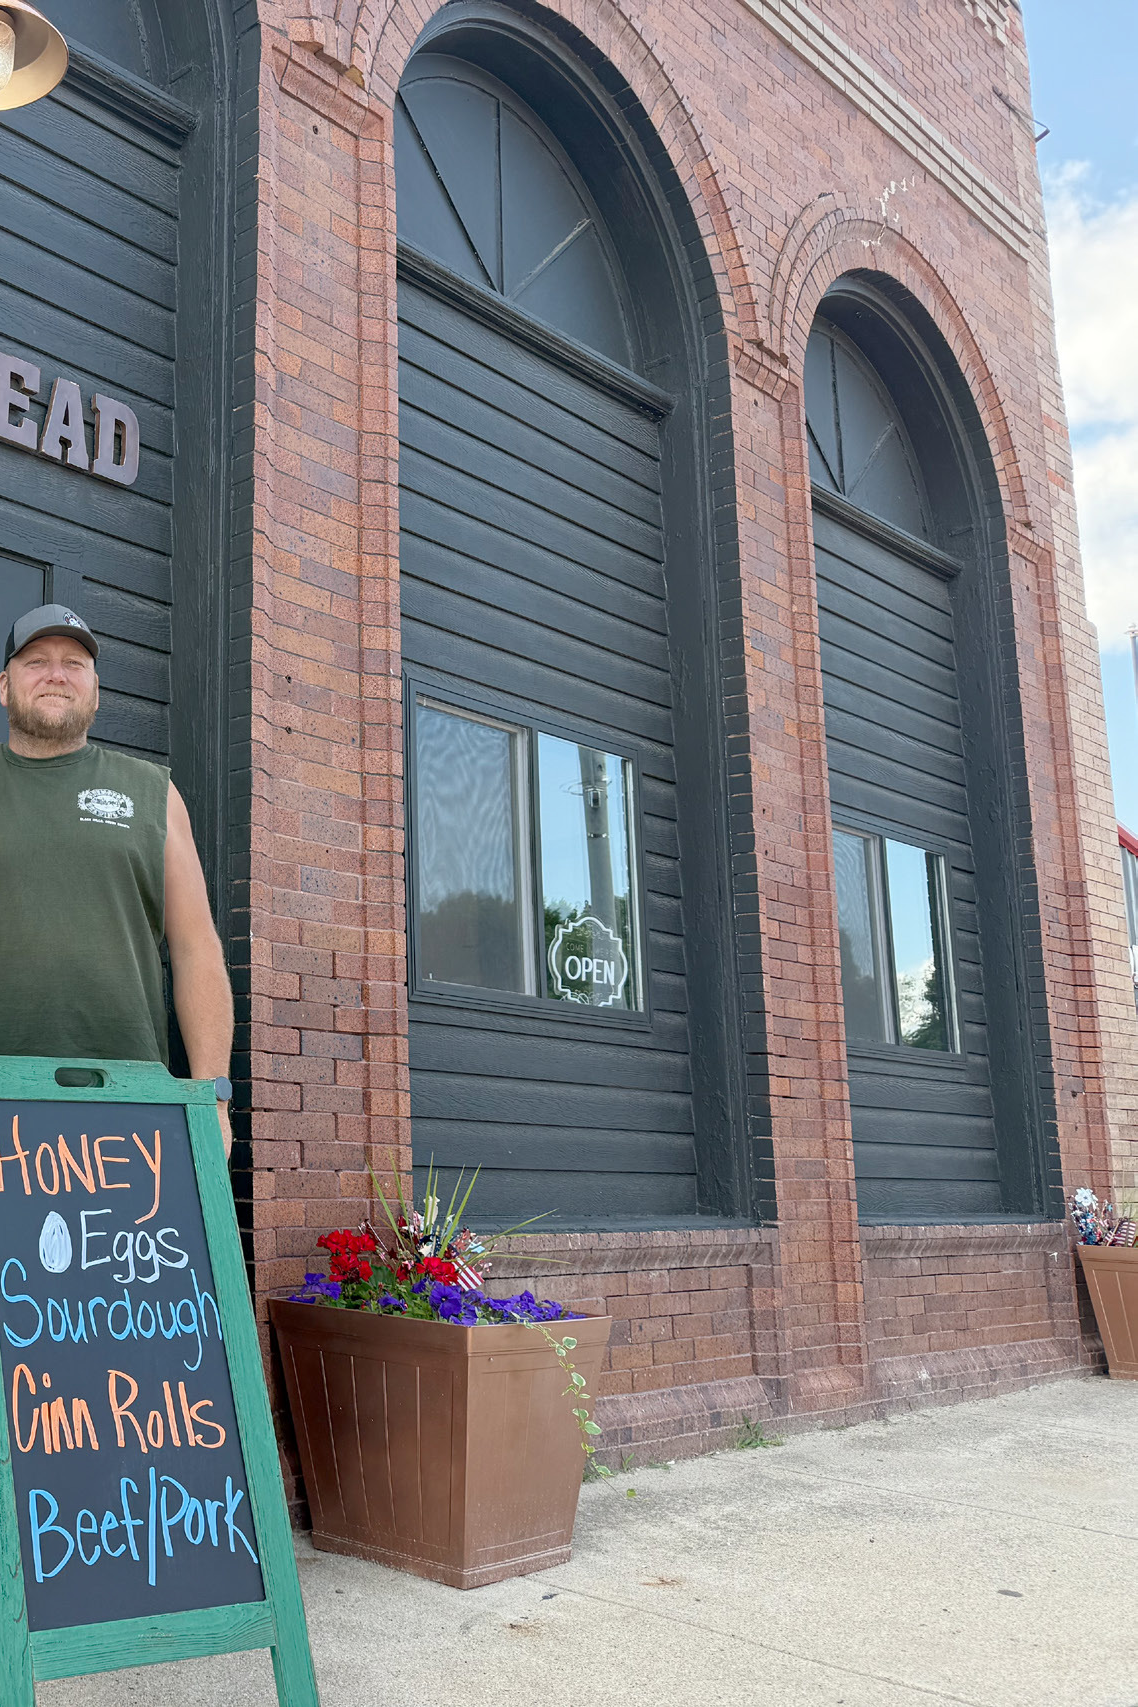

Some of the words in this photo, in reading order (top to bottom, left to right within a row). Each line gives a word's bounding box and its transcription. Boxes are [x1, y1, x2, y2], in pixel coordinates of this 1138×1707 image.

[565, 956, 615, 986] OPEN
[80, 1208, 189, 1283] Eggs
[0, 1257, 224, 1372] Sourdough
[12, 1363, 99, 1454] Cinn
[107, 1369, 226, 1454] Rolls
[28, 1466, 259, 1587] Beef/Pork
